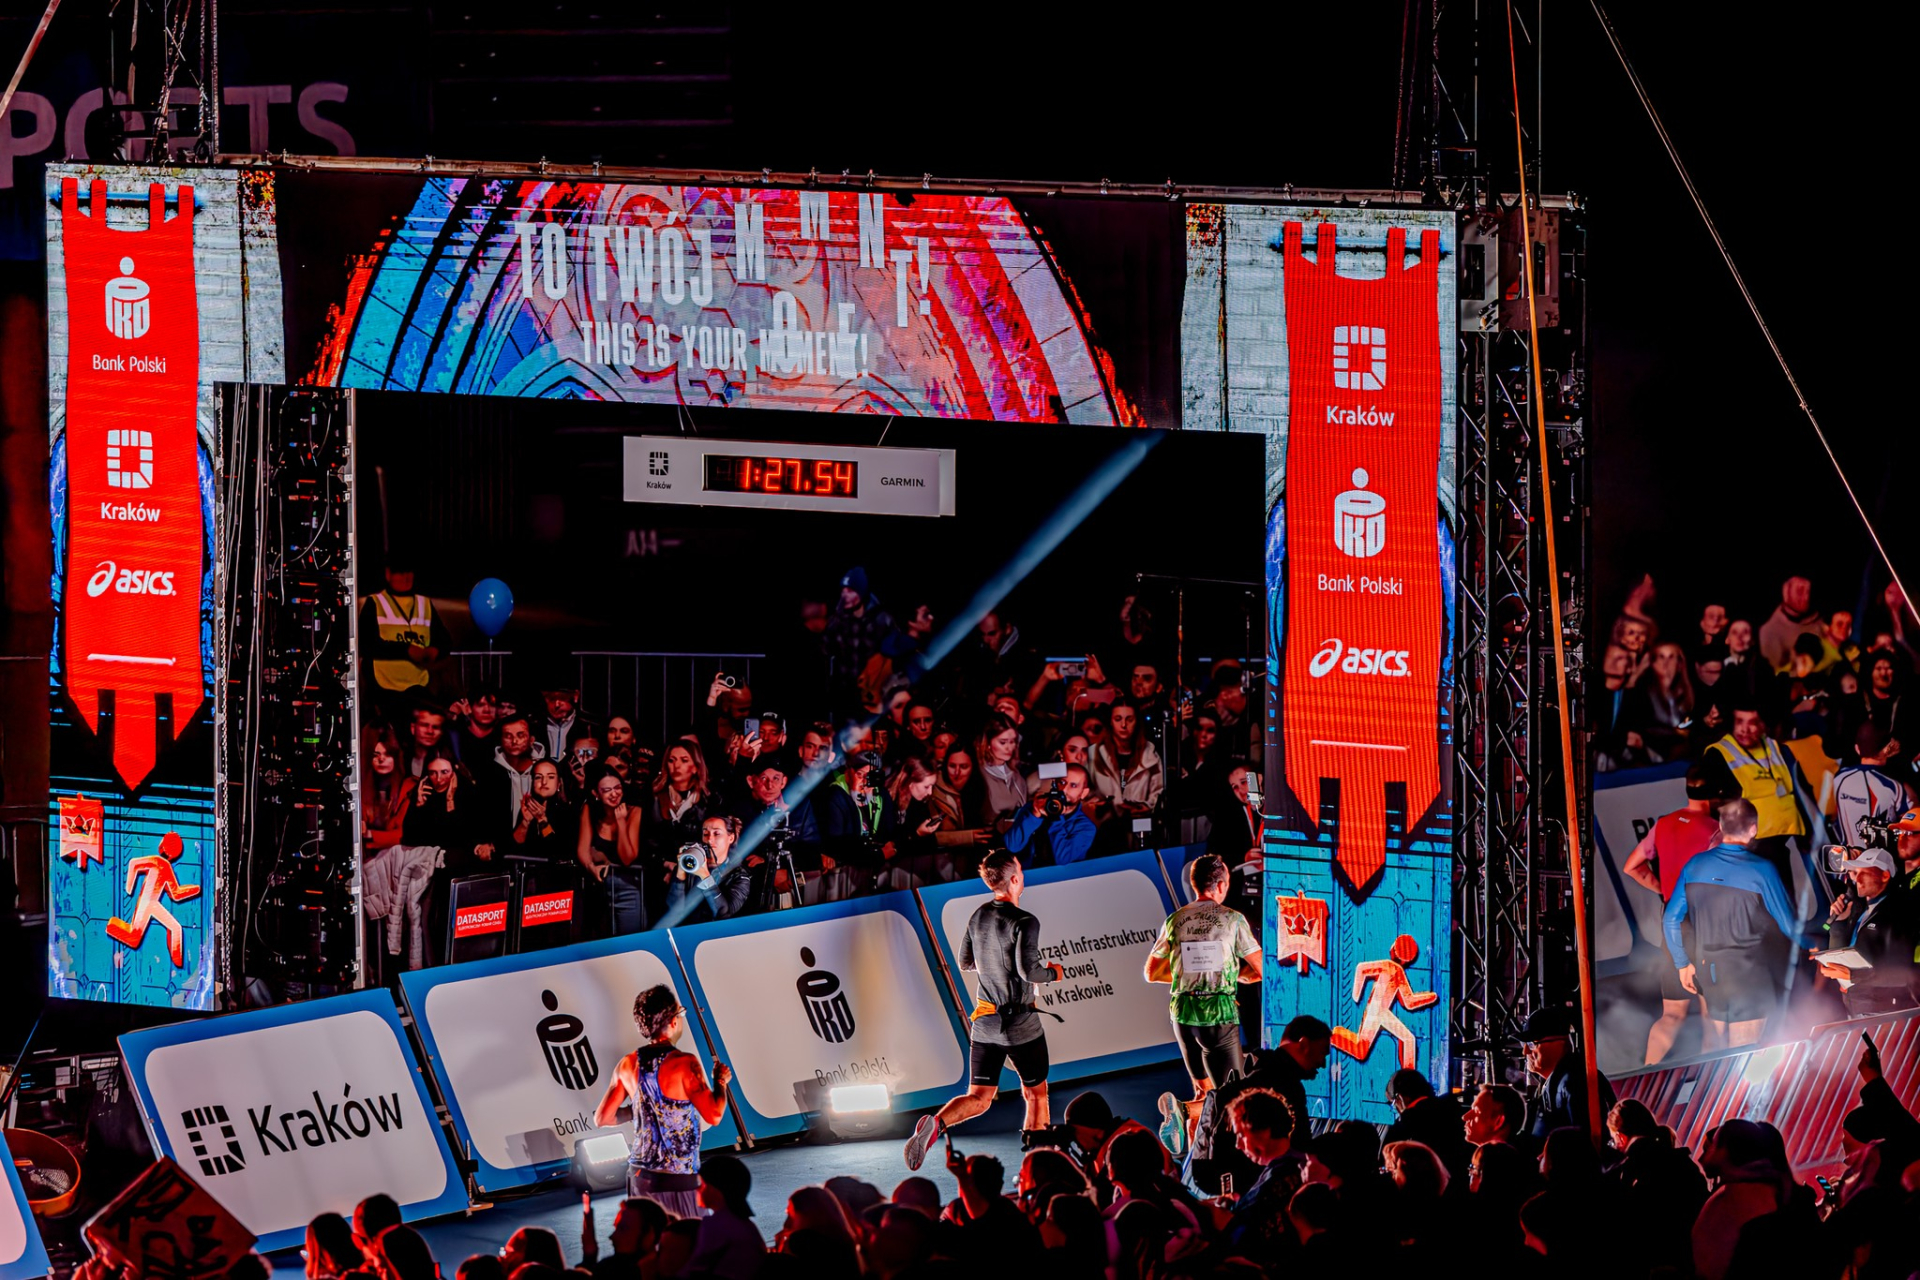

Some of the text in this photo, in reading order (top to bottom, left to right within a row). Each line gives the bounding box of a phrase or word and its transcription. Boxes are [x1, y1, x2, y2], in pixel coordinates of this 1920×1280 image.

[515, 221, 568, 300] TO
[589, 211, 713, 307] TWÓJ
[580, 320, 637, 367] THIS
[647, 323, 671, 369] IS
[682, 325, 748, 371] YOUR
[92, 354, 166, 374] Bank Polski
[1326, 405, 1395, 427] Kraków
[646, 481, 672, 490] Kraków
[743, 458, 852, 494] 1:27.54
[100, 502, 161, 523] Kraków
[1317, 574, 1403, 596] Bank Polski
[457, 909, 505, 926] DATASPORT
[524, 898, 571, 915] DATASPORT
[1069, 928, 1158, 955] Infrastruktury
[1042, 980, 1114, 1007] w Krakowie
[815, 1056, 891, 1087] Bank Polski
[248, 1082, 403, 1156] Kraków
[553, 1112, 592, 1136] Bank
